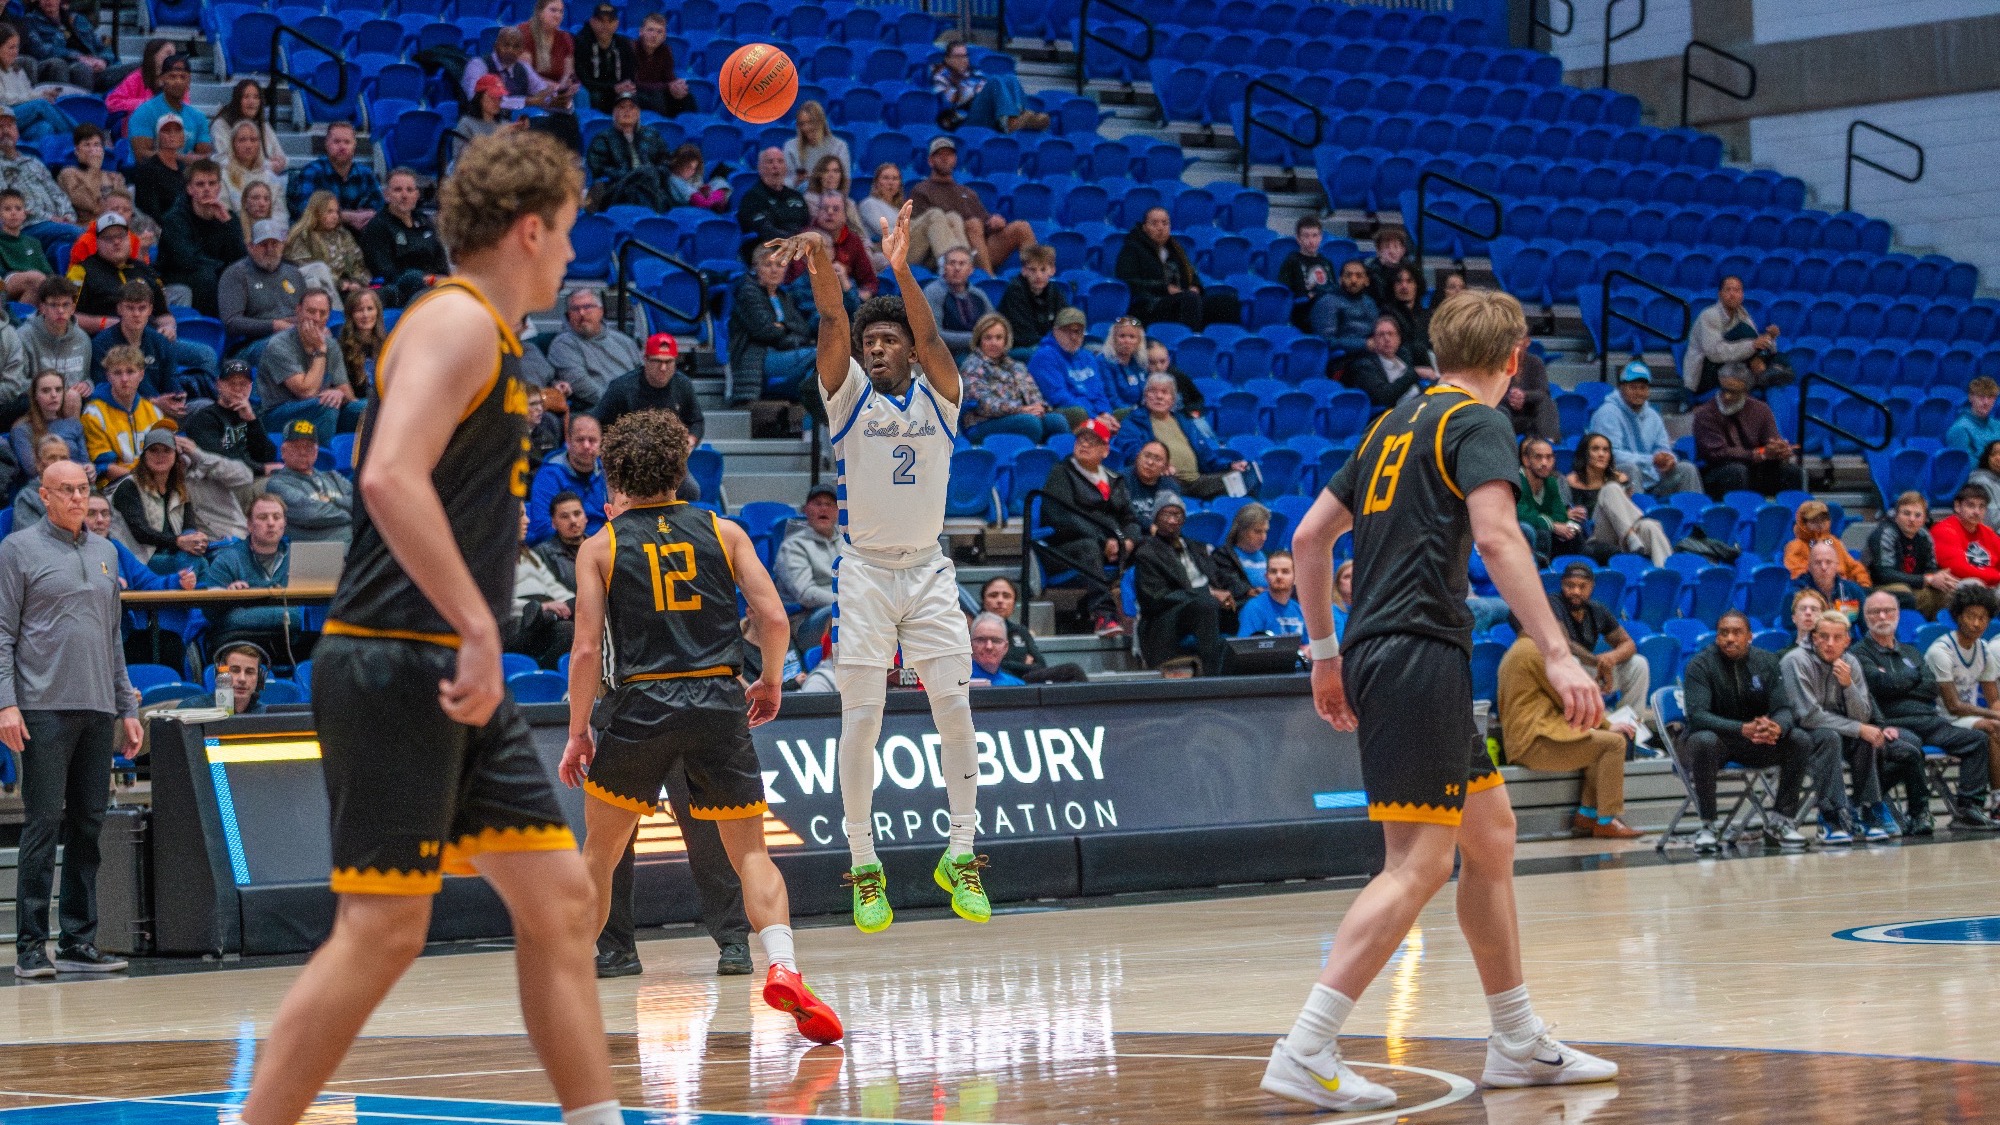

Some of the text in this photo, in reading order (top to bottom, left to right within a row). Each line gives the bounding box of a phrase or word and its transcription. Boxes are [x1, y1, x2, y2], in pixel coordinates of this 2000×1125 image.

[863, 419, 936, 438] Salt Lake
[893, 445, 915, 484] 2
[1362, 430, 1414, 516] 13
[642, 541, 702, 612] 12
[776, 726, 1105, 795] WODBURY
[810, 799, 1119, 845] CRPORATION
